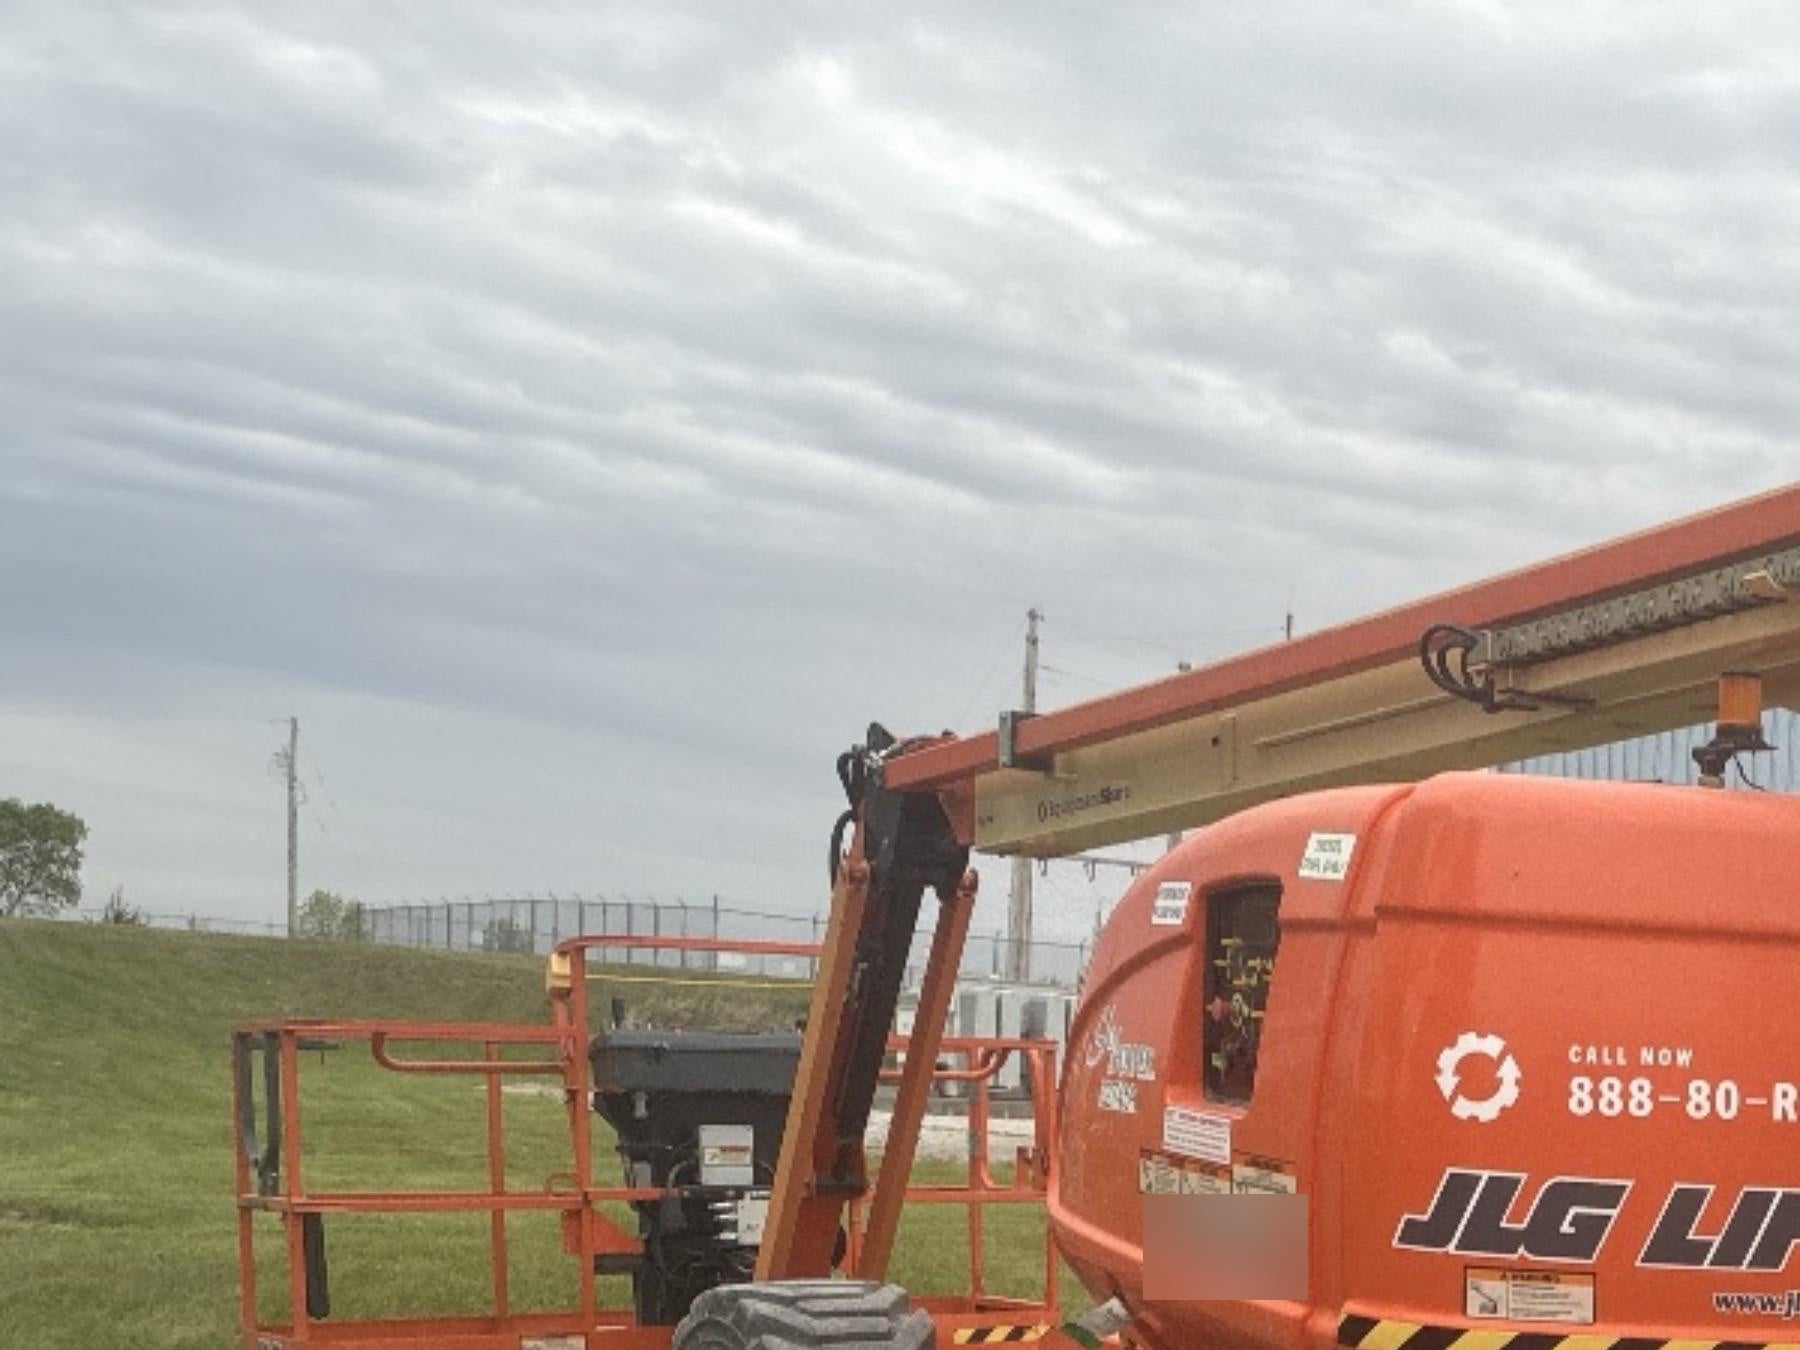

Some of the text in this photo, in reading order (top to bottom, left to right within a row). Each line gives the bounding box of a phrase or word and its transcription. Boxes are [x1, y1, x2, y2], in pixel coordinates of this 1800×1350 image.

[1568, 1044, 1694, 1069] CALL NOW
[1392, 1166, 1635, 1264] JLG
